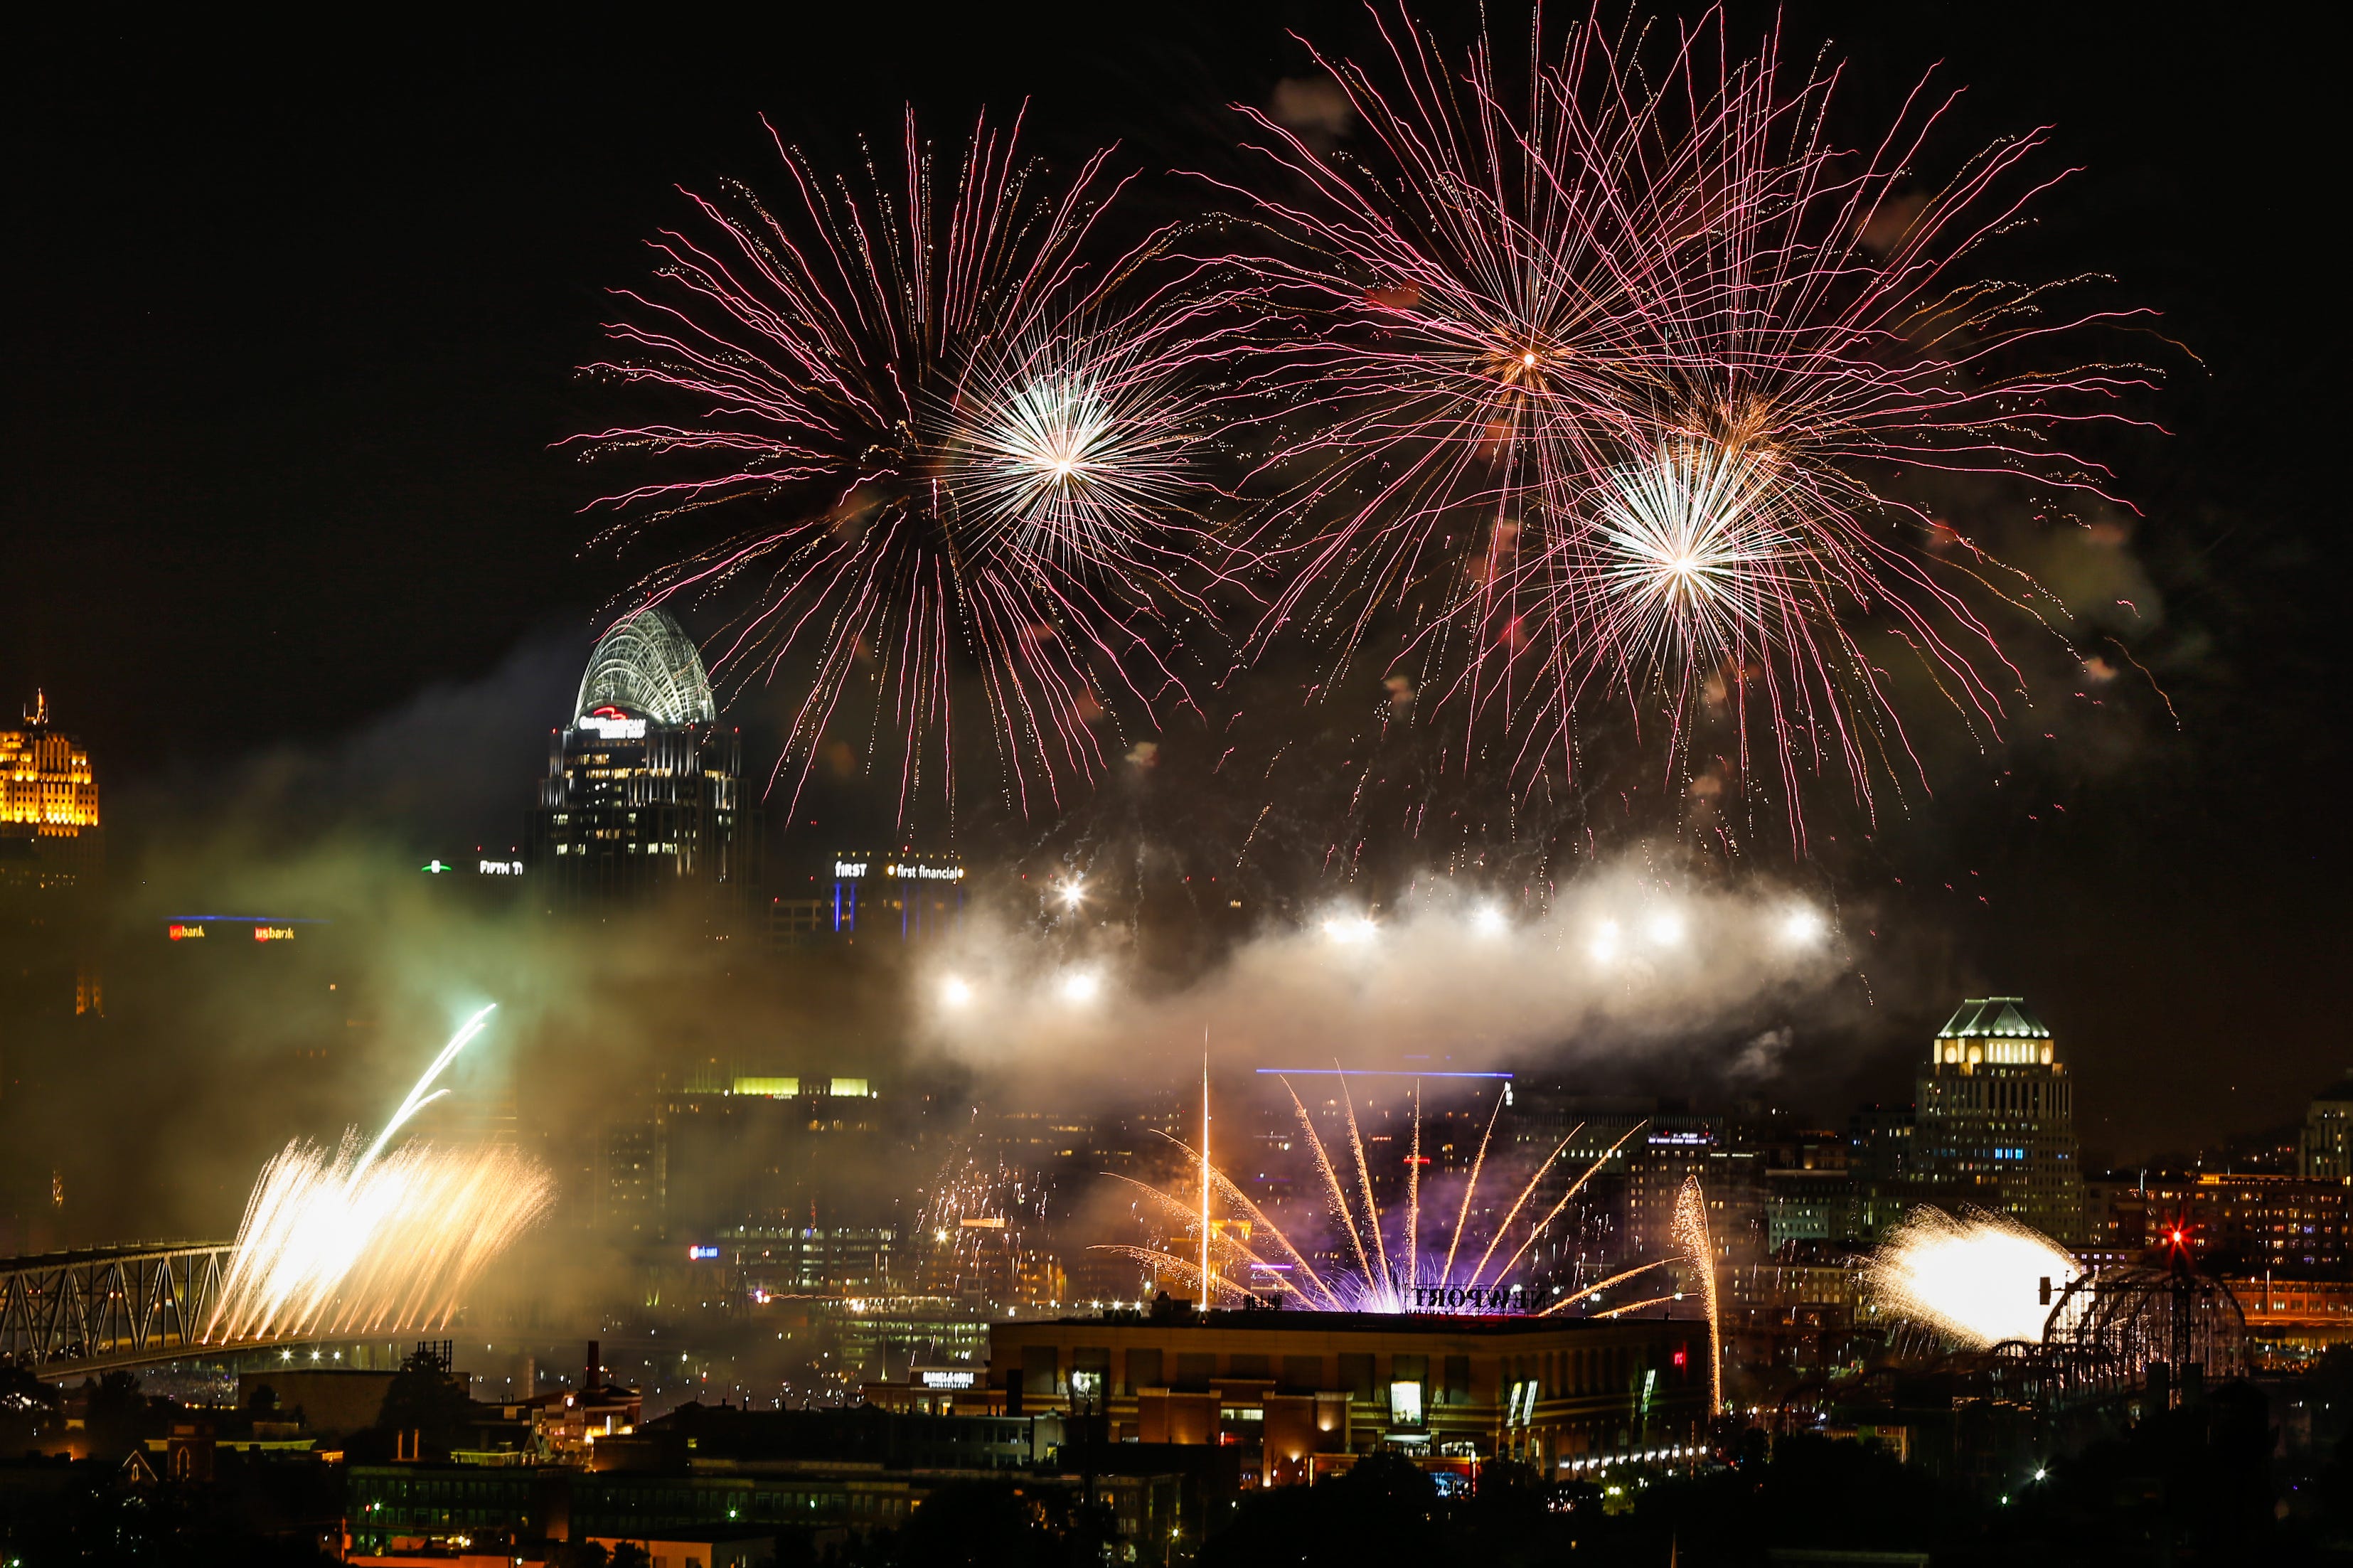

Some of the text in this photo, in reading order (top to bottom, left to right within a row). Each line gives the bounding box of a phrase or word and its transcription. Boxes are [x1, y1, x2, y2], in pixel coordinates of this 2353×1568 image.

[480, 860, 510, 875] FIFTH
[897, 863, 957, 880] first financial
